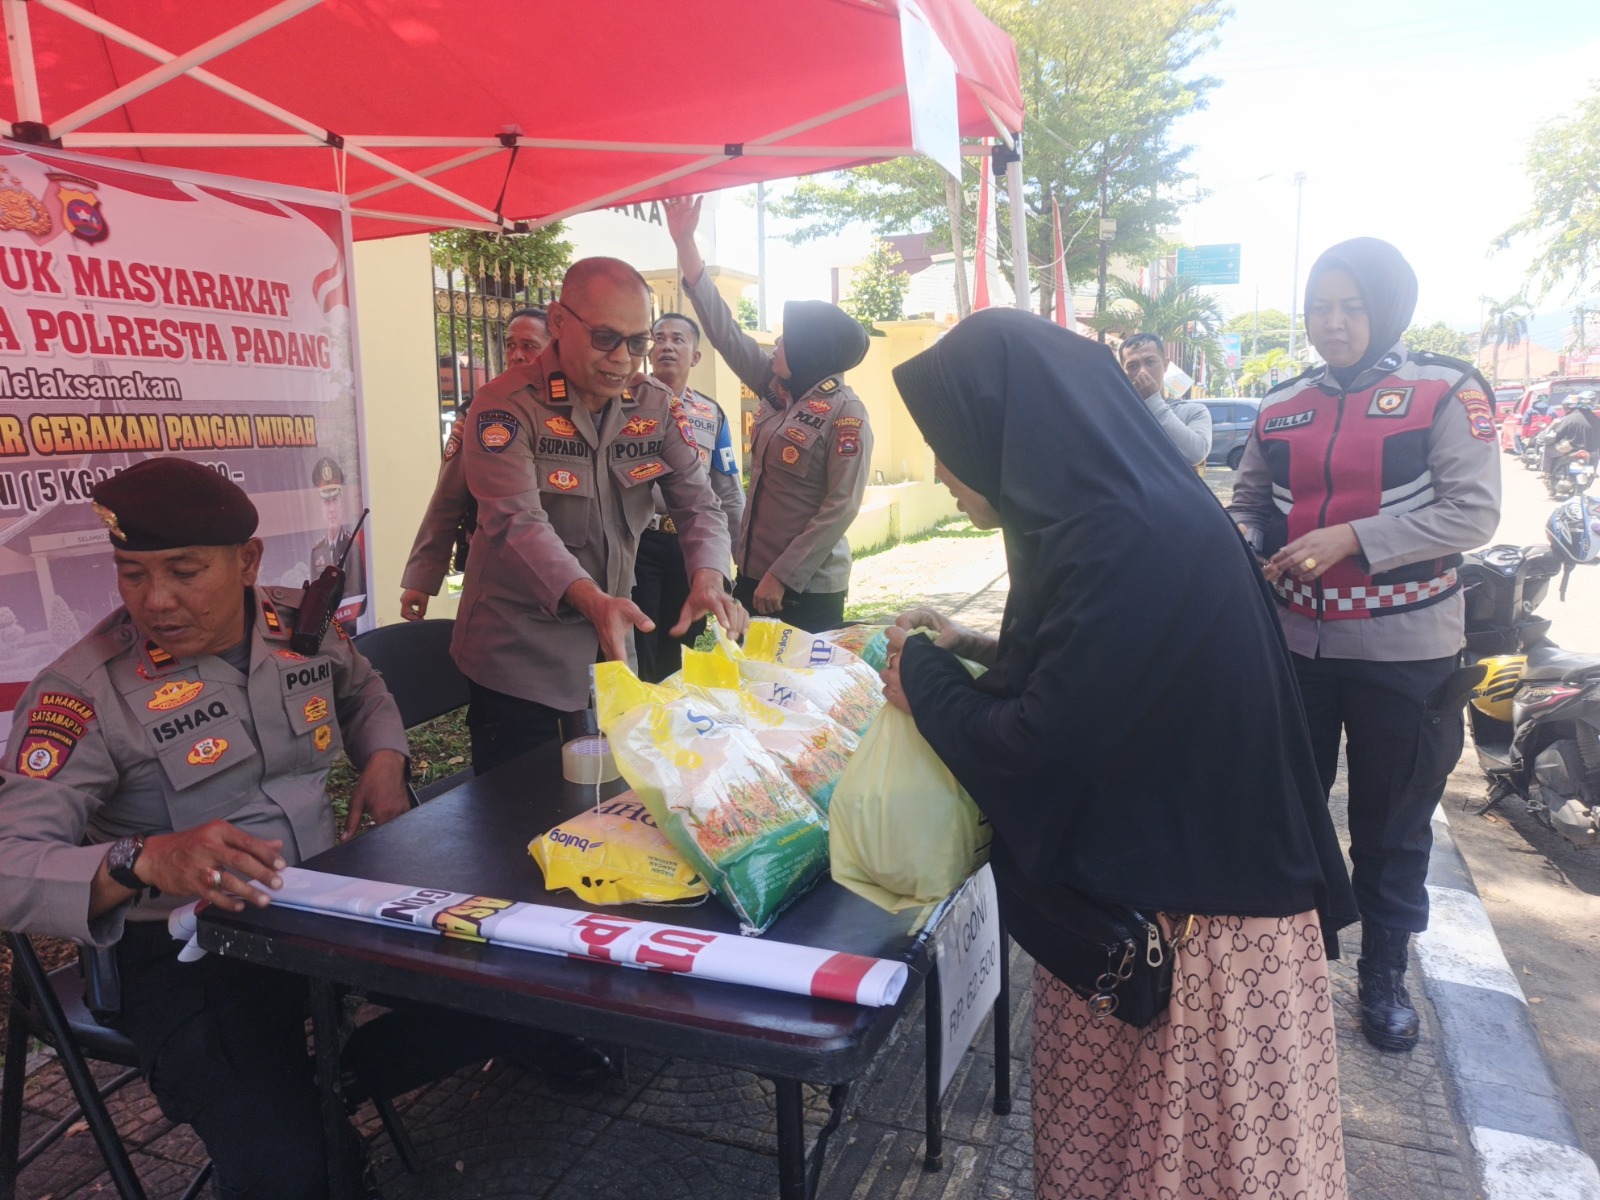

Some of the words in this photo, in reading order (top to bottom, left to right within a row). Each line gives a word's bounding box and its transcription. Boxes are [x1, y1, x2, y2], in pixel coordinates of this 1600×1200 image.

[67, 254, 291, 317] MASYARAKAT
[26, 308, 228, 361] POLRESTA
[231, 326, 332, 370] PADANG
[688, 418, 715, 432] POLRI
[792, 410, 826, 430] POLRI
[0, 414, 29, 455] R
[29, 413, 164, 455] GERAKAN
[163, 413, 254, 449] PANGAN
[254, 415, 317, 447] MURAH
[539, 436, 589, 458] SUPARDI
[615, 440, 663, 459] POLRI
[286, 662, 330, 690] POLRI
[43, 694, 93, 720] BAHARKAM
[32, 710, 83, 736] SATSAMAPTA
[153, 701, 229, 744] ISHAQ
[548, 828, 590, 853] bulog
[962, 894, 988, 953] GONI
[966, 940, 996, 1010] 62.500
